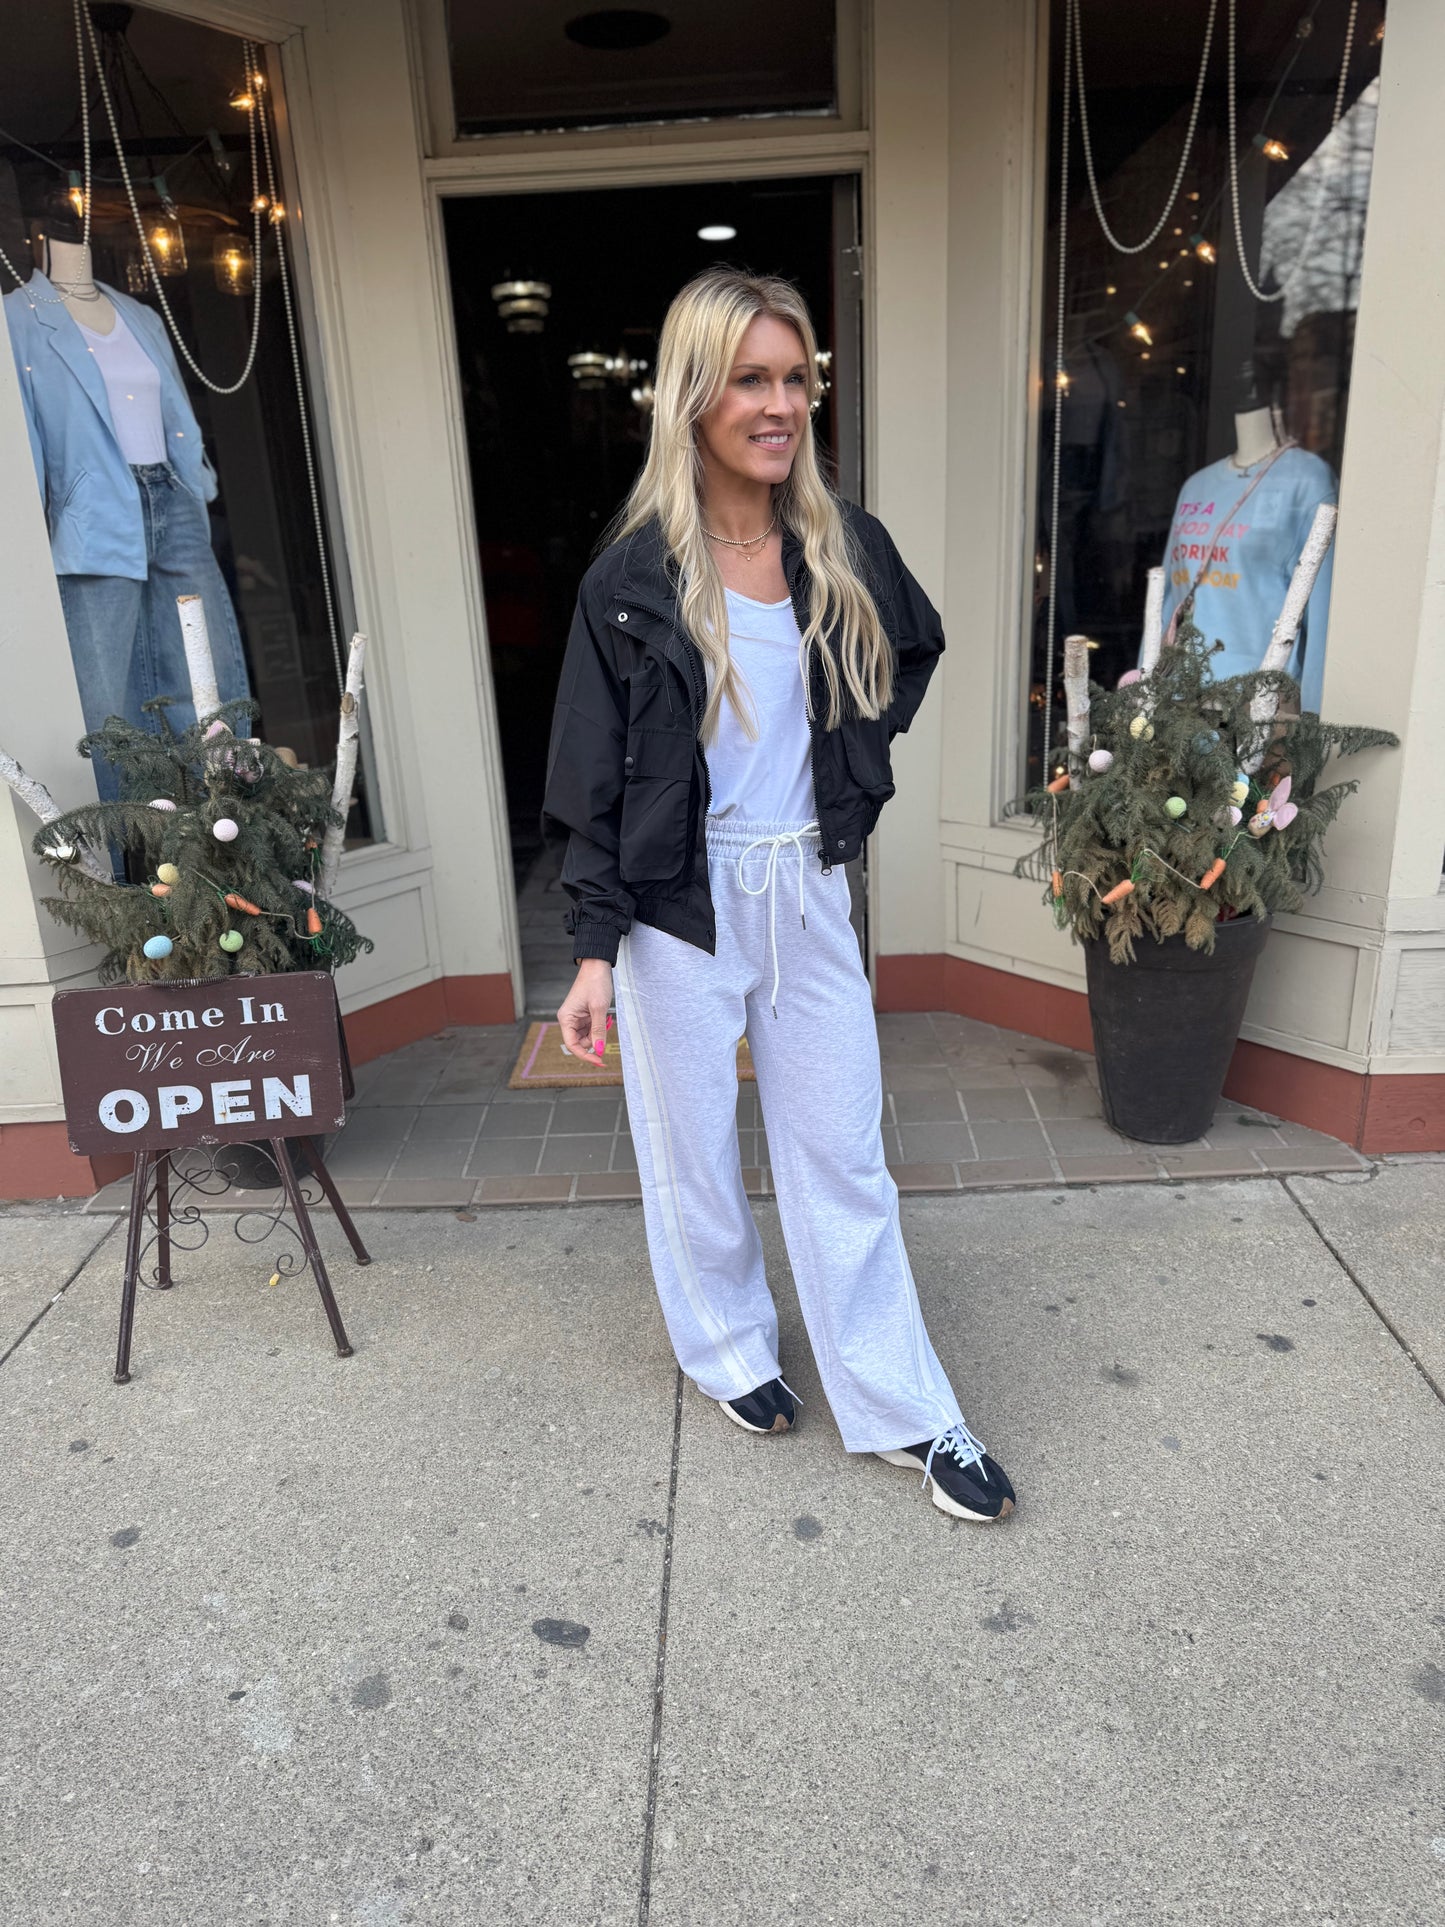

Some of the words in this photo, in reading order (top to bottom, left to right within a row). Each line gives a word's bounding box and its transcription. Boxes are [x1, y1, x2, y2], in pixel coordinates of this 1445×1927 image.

[1200, 501, 1215, 516] A
[1217, 522, 1250, 540] AY
[95, 1006, 224, 1036] Come
[237, 996, 288, 1025] In
[125, 1040, 184, 1073] We
[196, 1035, 276, 1067] Are
[98, 1074, 313, 1134] OPEN
